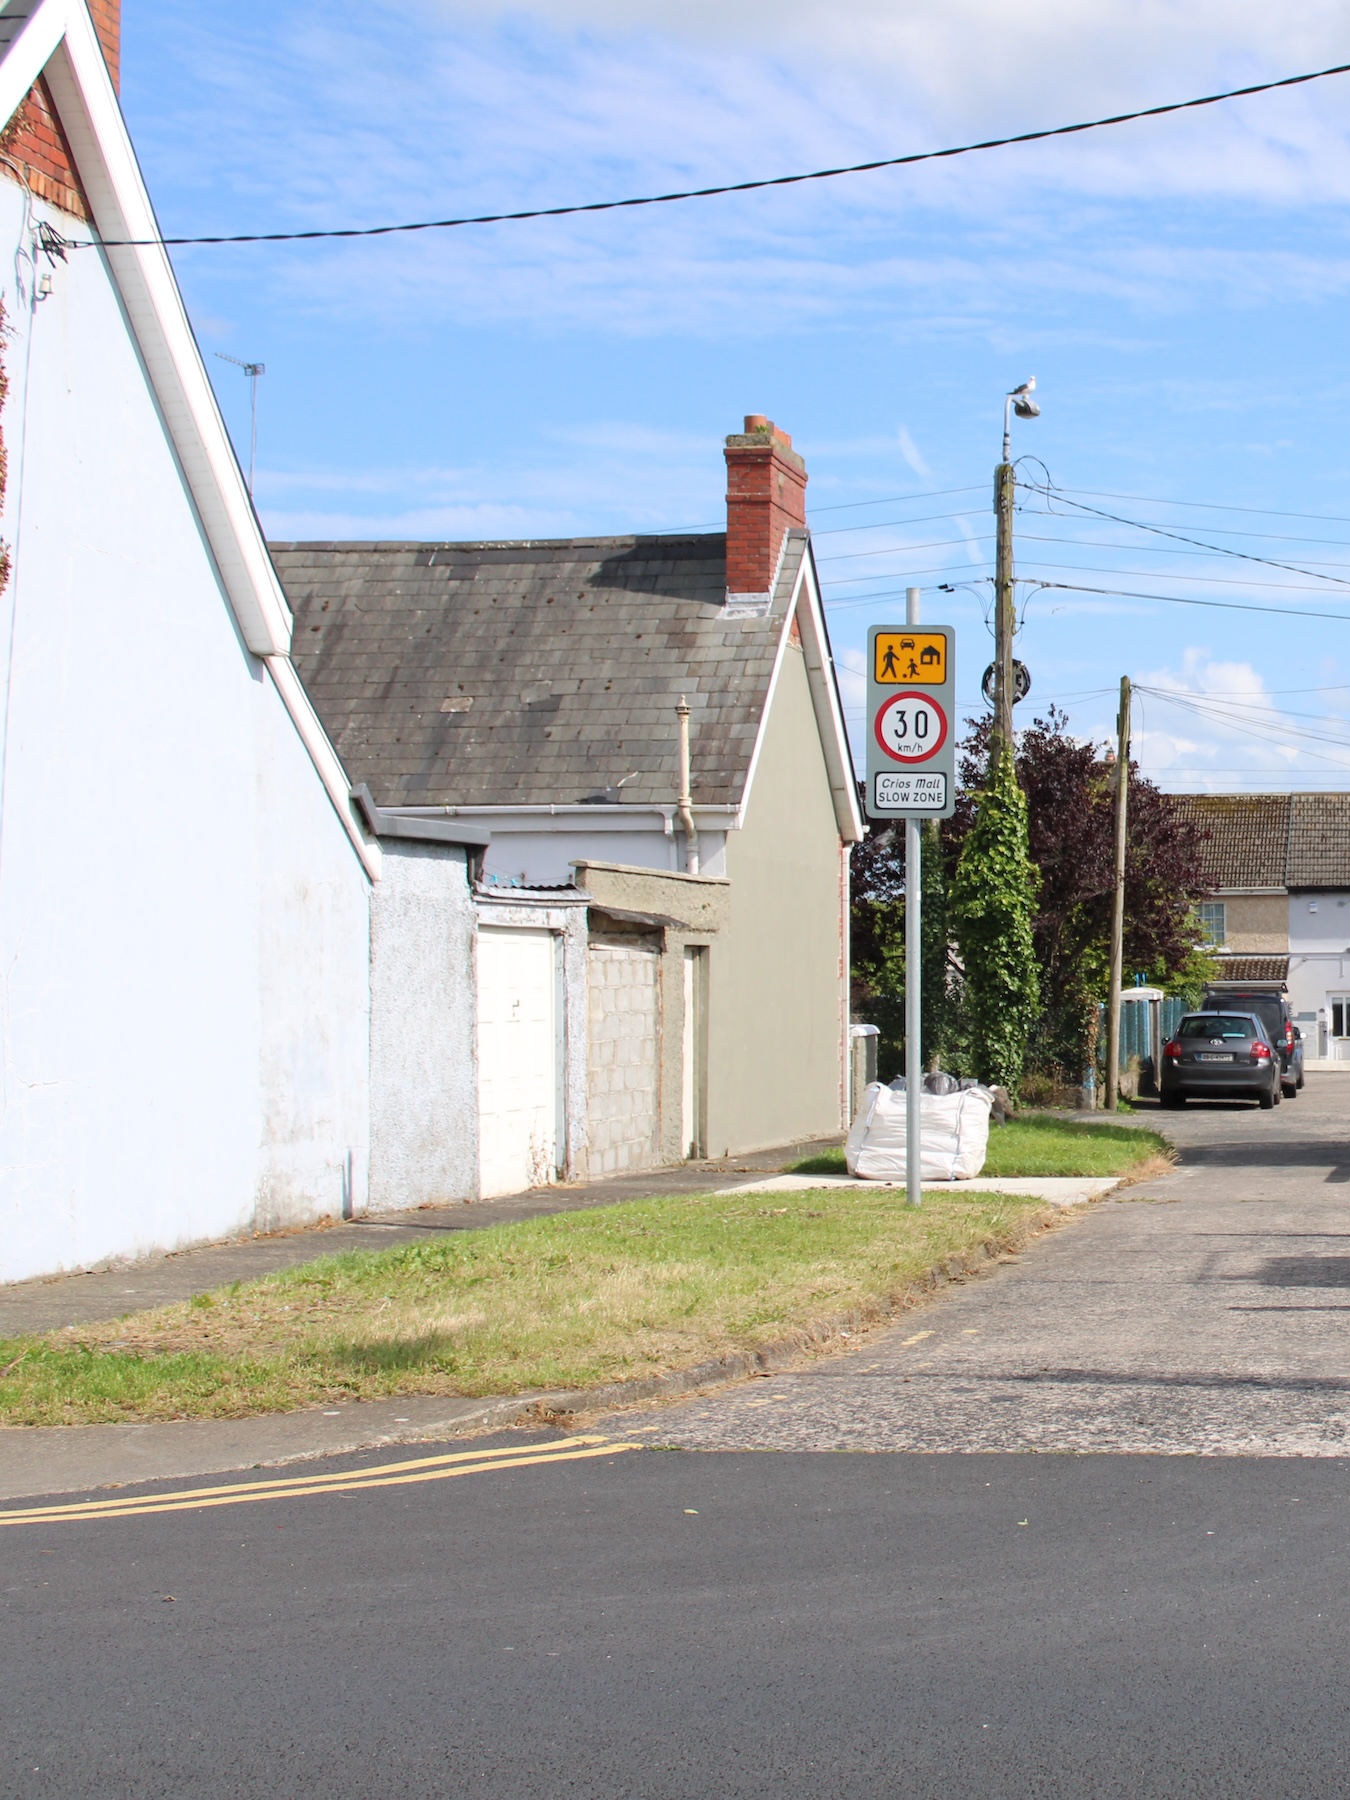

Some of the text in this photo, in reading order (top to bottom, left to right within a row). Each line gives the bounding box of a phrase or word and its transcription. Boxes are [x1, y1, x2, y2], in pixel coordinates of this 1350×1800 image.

[894, 710, 928, 739] 30
[897, 743, 923, 753] km/h
[882, 778, 940, 789] Crios Mall
[878, 792, 943, 802] SLOW ZONE
